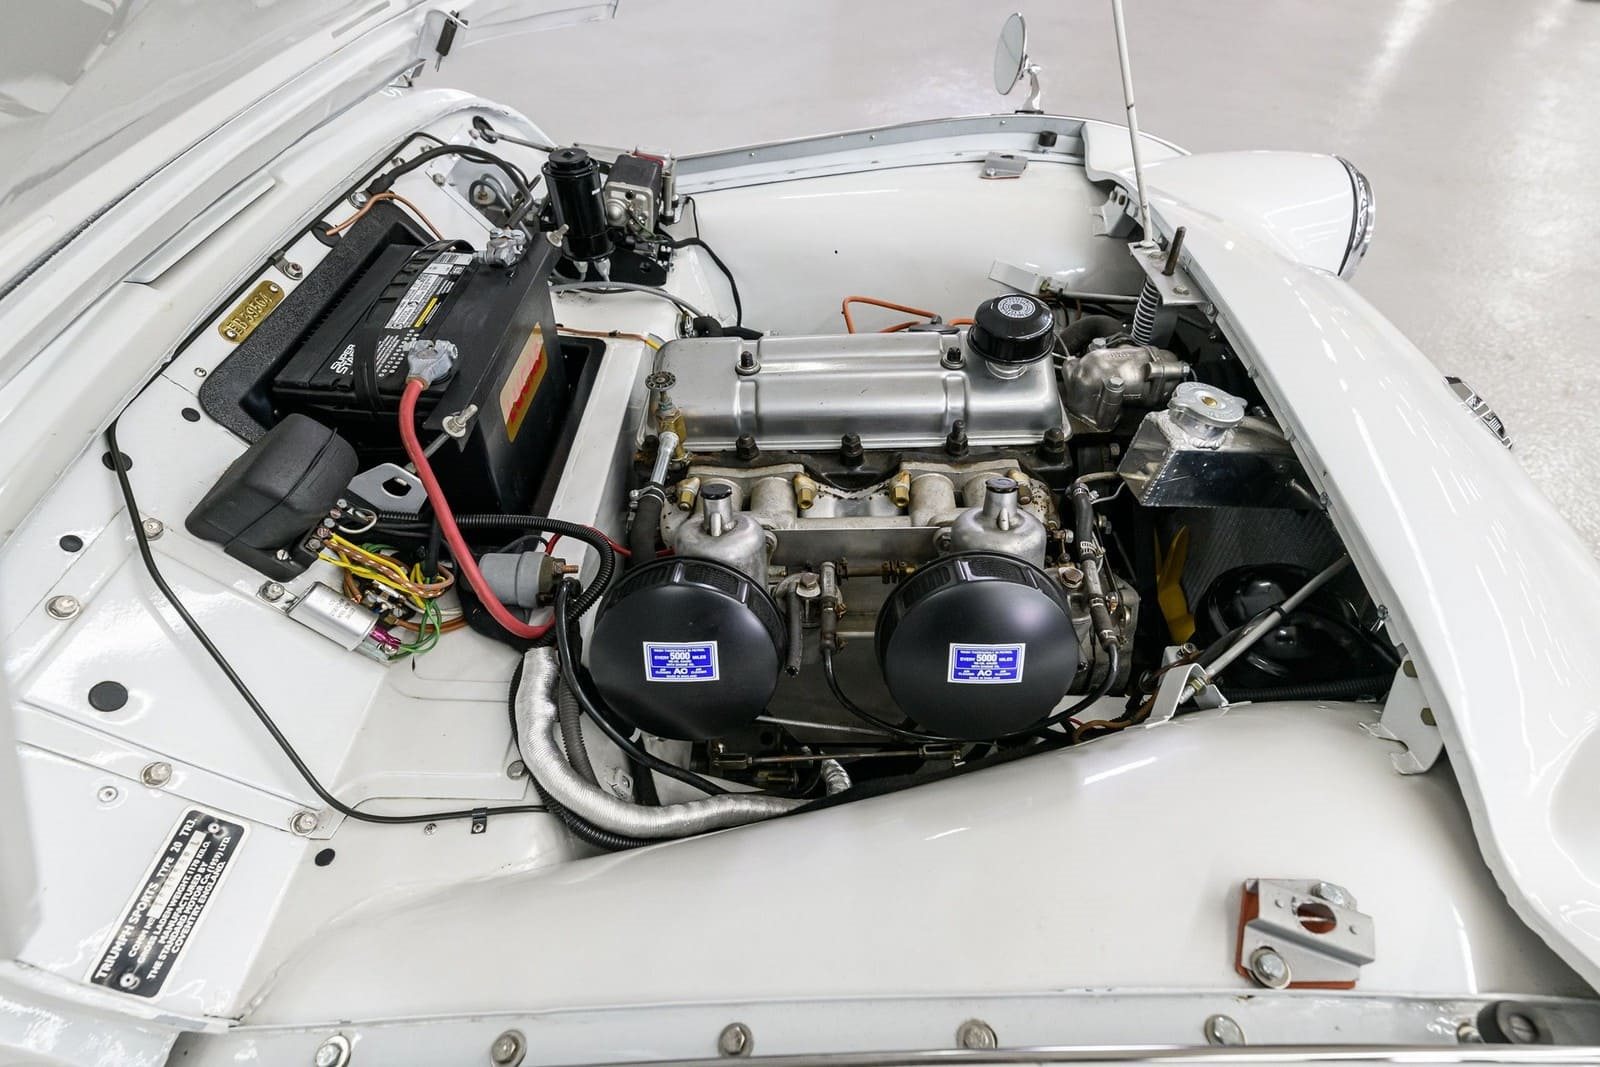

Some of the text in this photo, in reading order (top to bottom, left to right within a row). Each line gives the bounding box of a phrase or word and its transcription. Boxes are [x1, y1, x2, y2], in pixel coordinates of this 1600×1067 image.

[330, 344, 355, 370] SUPER
[670, 652, 690, 660] 5000
[976, 654, 998, 662] 5000
[94, 924, 135, 979] TRIUMPH
[127, 881, 159, 924] SPORTS
[156, 857, 175, 878] TYPE
[170, 841, 184, 853] 20
[156, 873, 202, 944] MANUFACTURED
[196, 861, 209, 873] BY
[135, 934, 158, 964] GROSS
[152, 906, 175, 935] LADEN
[145, 959, 164, 980] THE
[156, 913, 188, 960] STANDARD
[182, 885, 204, 914] MOTOR
